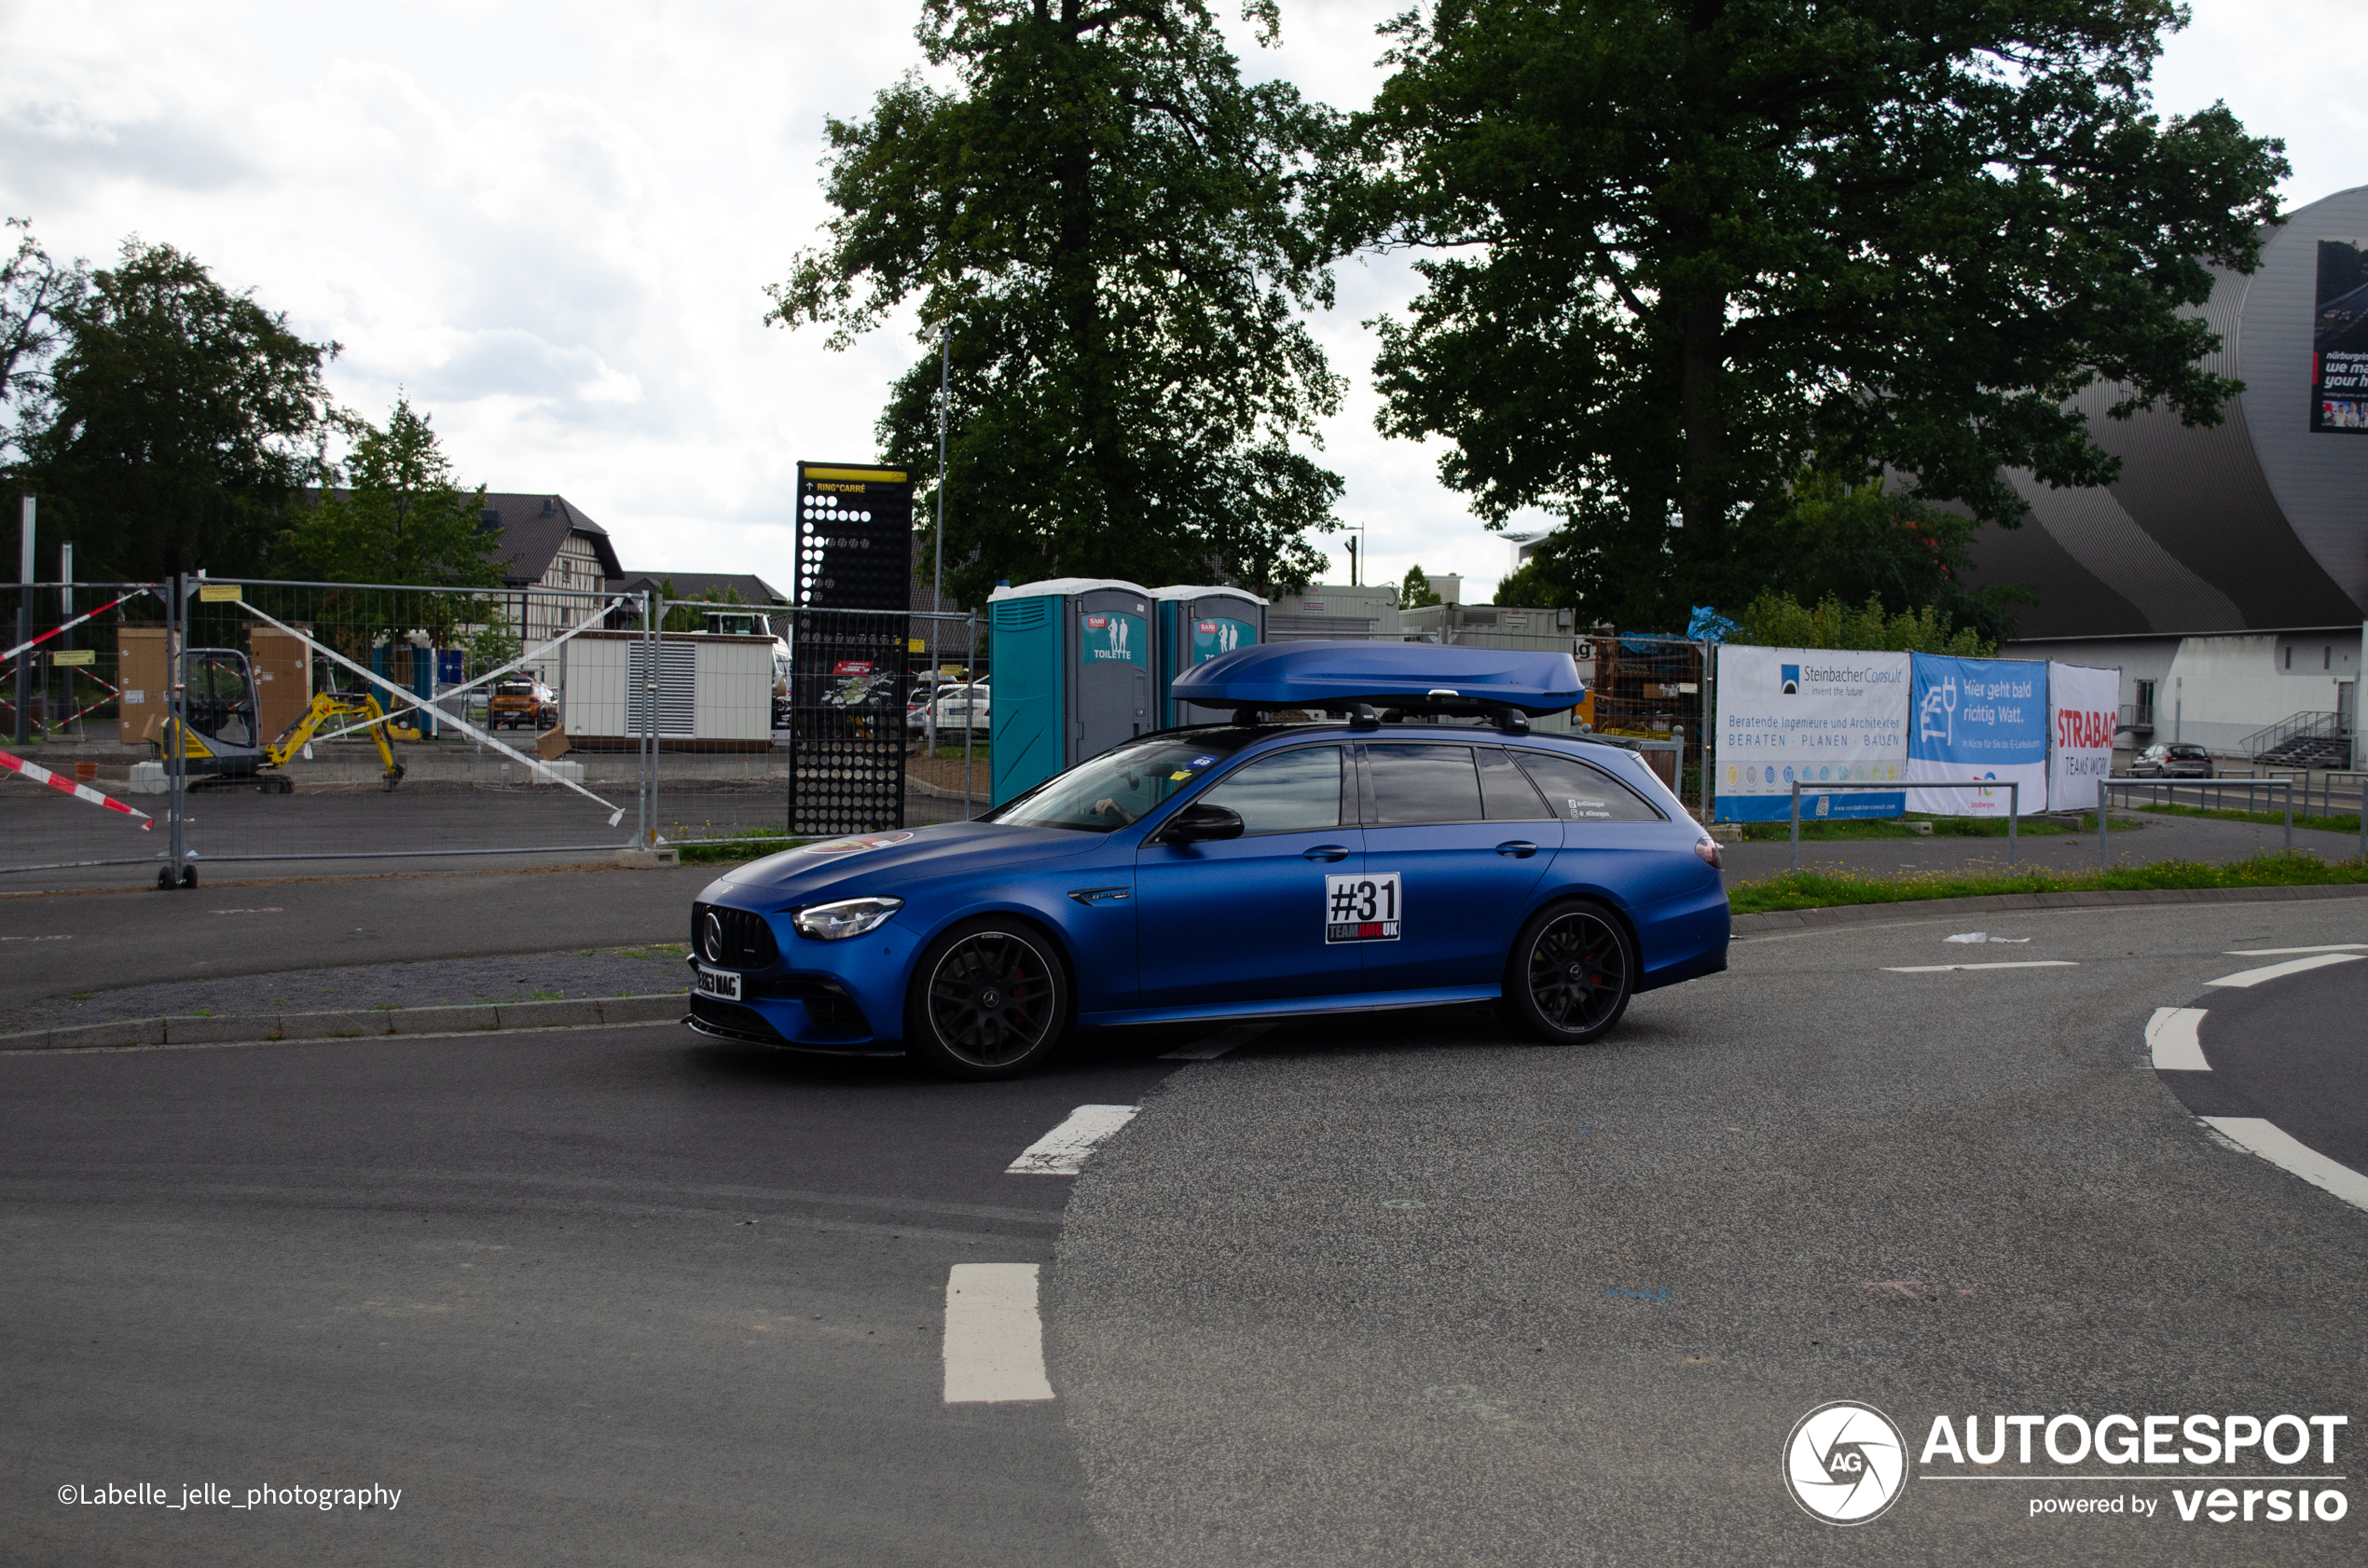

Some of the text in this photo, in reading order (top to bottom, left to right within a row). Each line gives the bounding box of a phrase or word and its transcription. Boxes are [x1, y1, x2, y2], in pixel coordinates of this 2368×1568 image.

[2325, 362, 2347, 374] we
[2324, 375, 2358, 389] your
[1094, 649, 1132, 660] TOILETTE
[1811, 686, 1832, 695] invent
[1833, 687, 1844, 696] the
[1845, 687, 1864, 696] future
[1963, 679, 2032, 700] Hier geht bald
[1729, 715, 1899, 731] Beratende Ingenieure und Architekten
[1963, 704, 2024, 726] richtig Watt.
[2058, 708, 2116, 750] STRABAG
[1729, 735, 1899, 747] BERATEN PLANEN BAUEN
[2065, 756, 2109, 775] TEAMS WORK
[1330, 880, 1395, 921] #31
